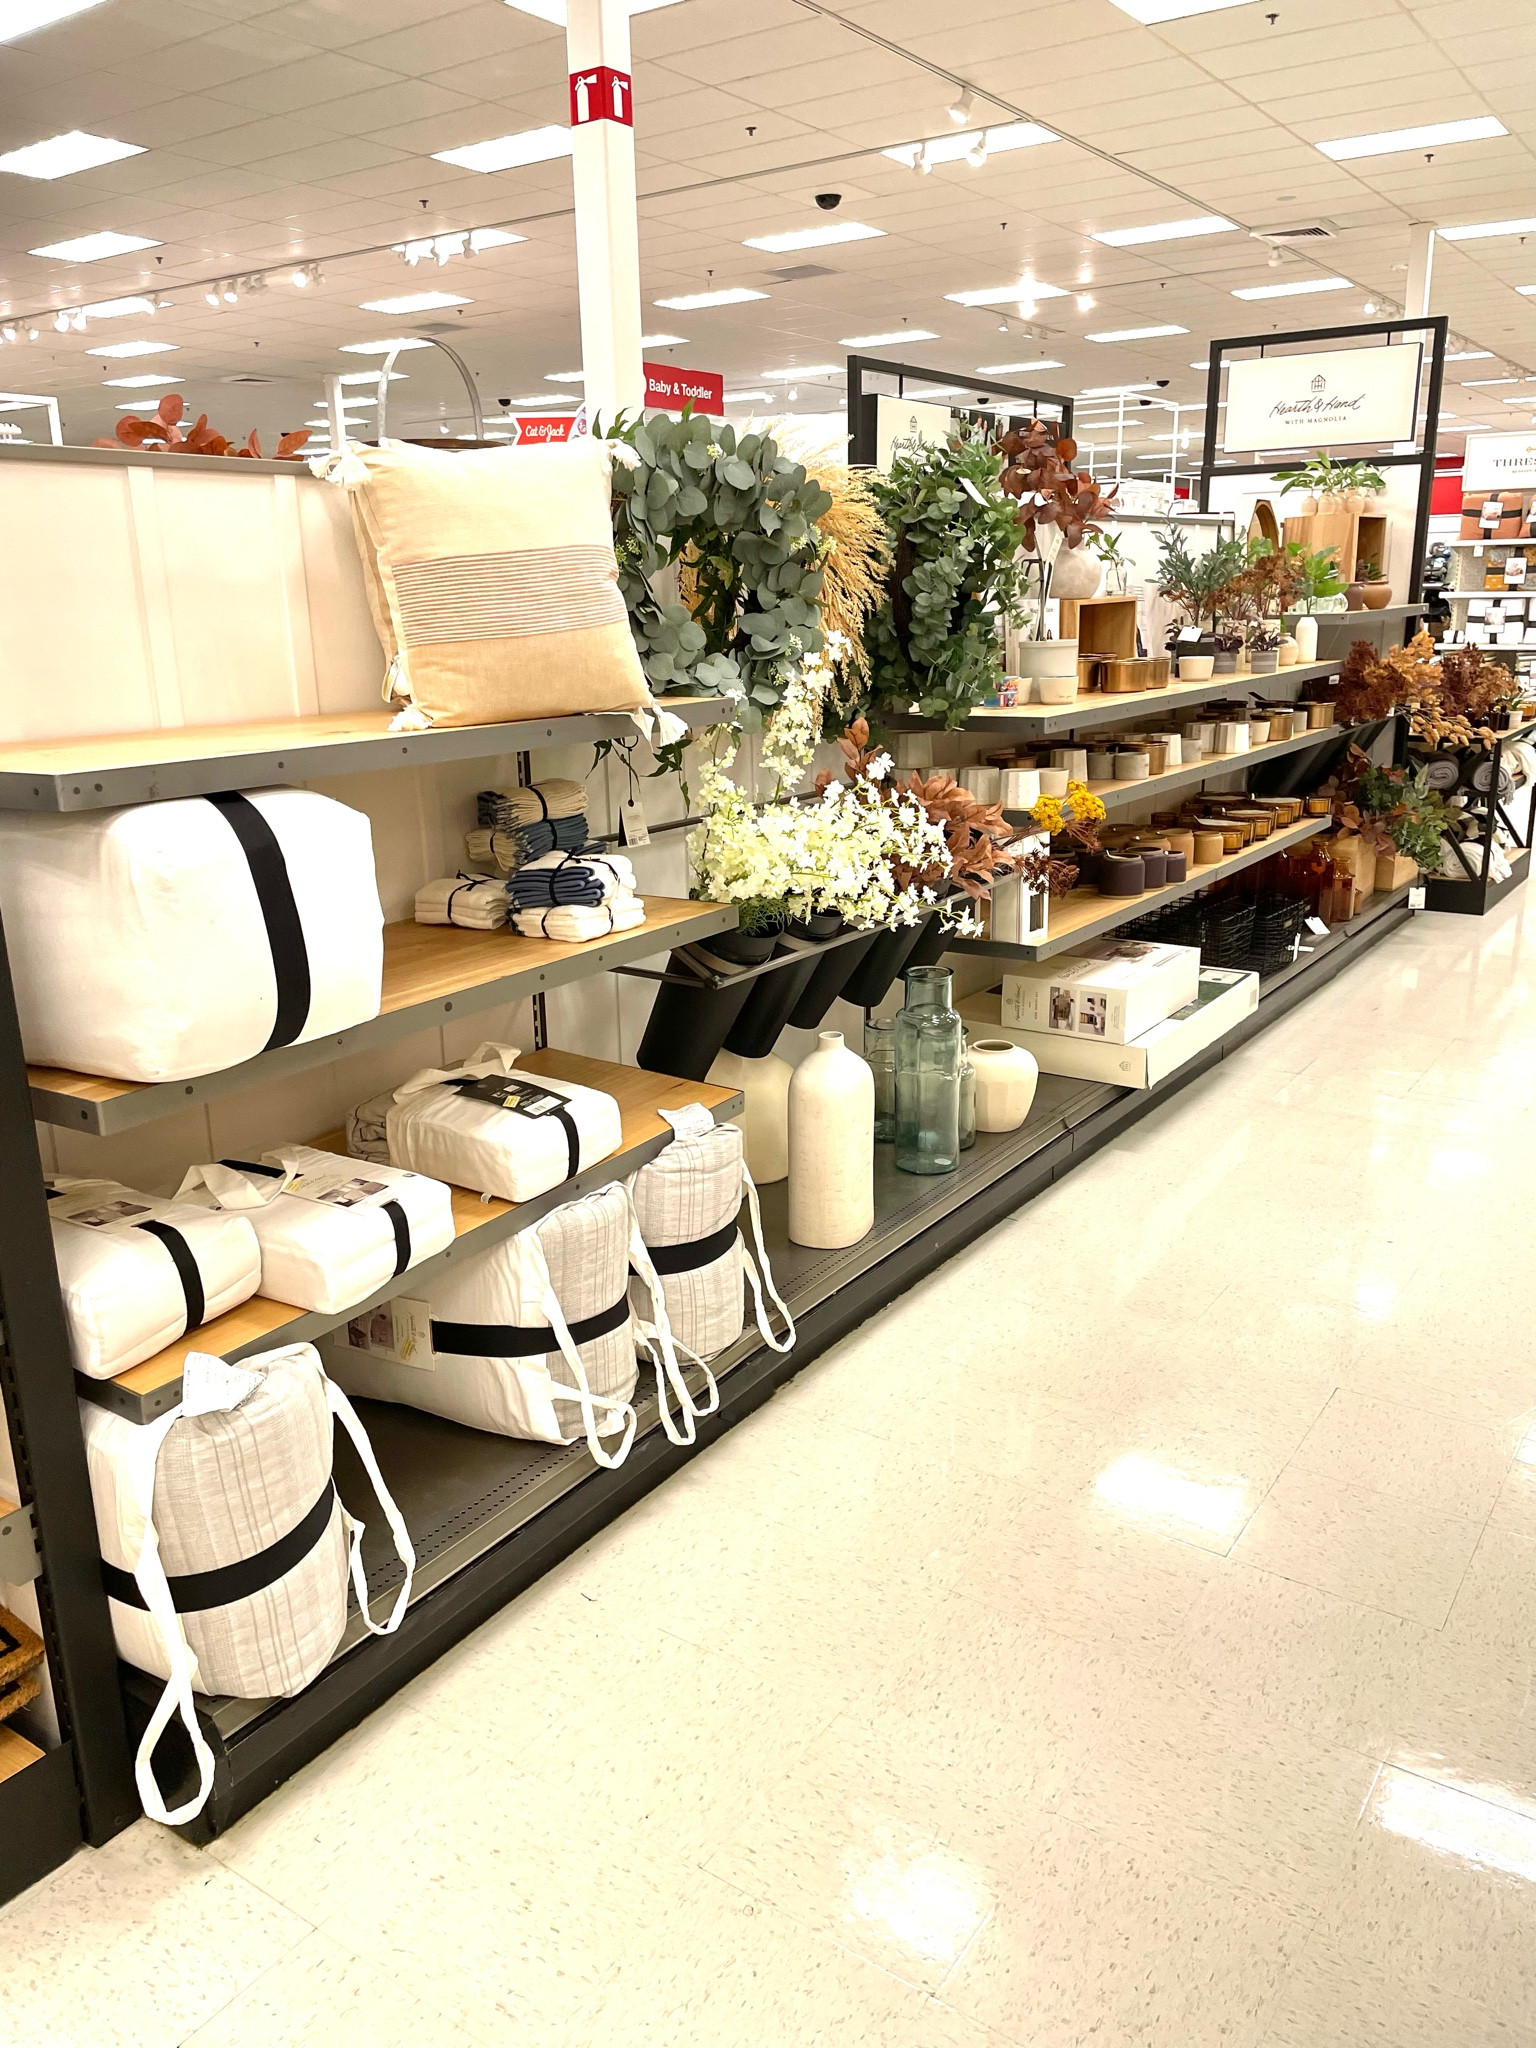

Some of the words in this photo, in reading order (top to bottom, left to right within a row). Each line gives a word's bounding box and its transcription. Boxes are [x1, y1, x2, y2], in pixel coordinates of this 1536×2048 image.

[649, 379, 671, 396] Baby
[673, 382, 680, 395] &
[681, 384, 713, 400] Toddler
[1269, 396, 1317, 417] Hearth
[1314, 398, 1323, 413] &
[1322, 394, 1366, 412] Hand
[1307, 416, 1347, 424] MAGNOLIA
[525, 425, 539, 437] Cat
[538, 425, 547, 437] &
[546, 424, 566, 443] Jack
